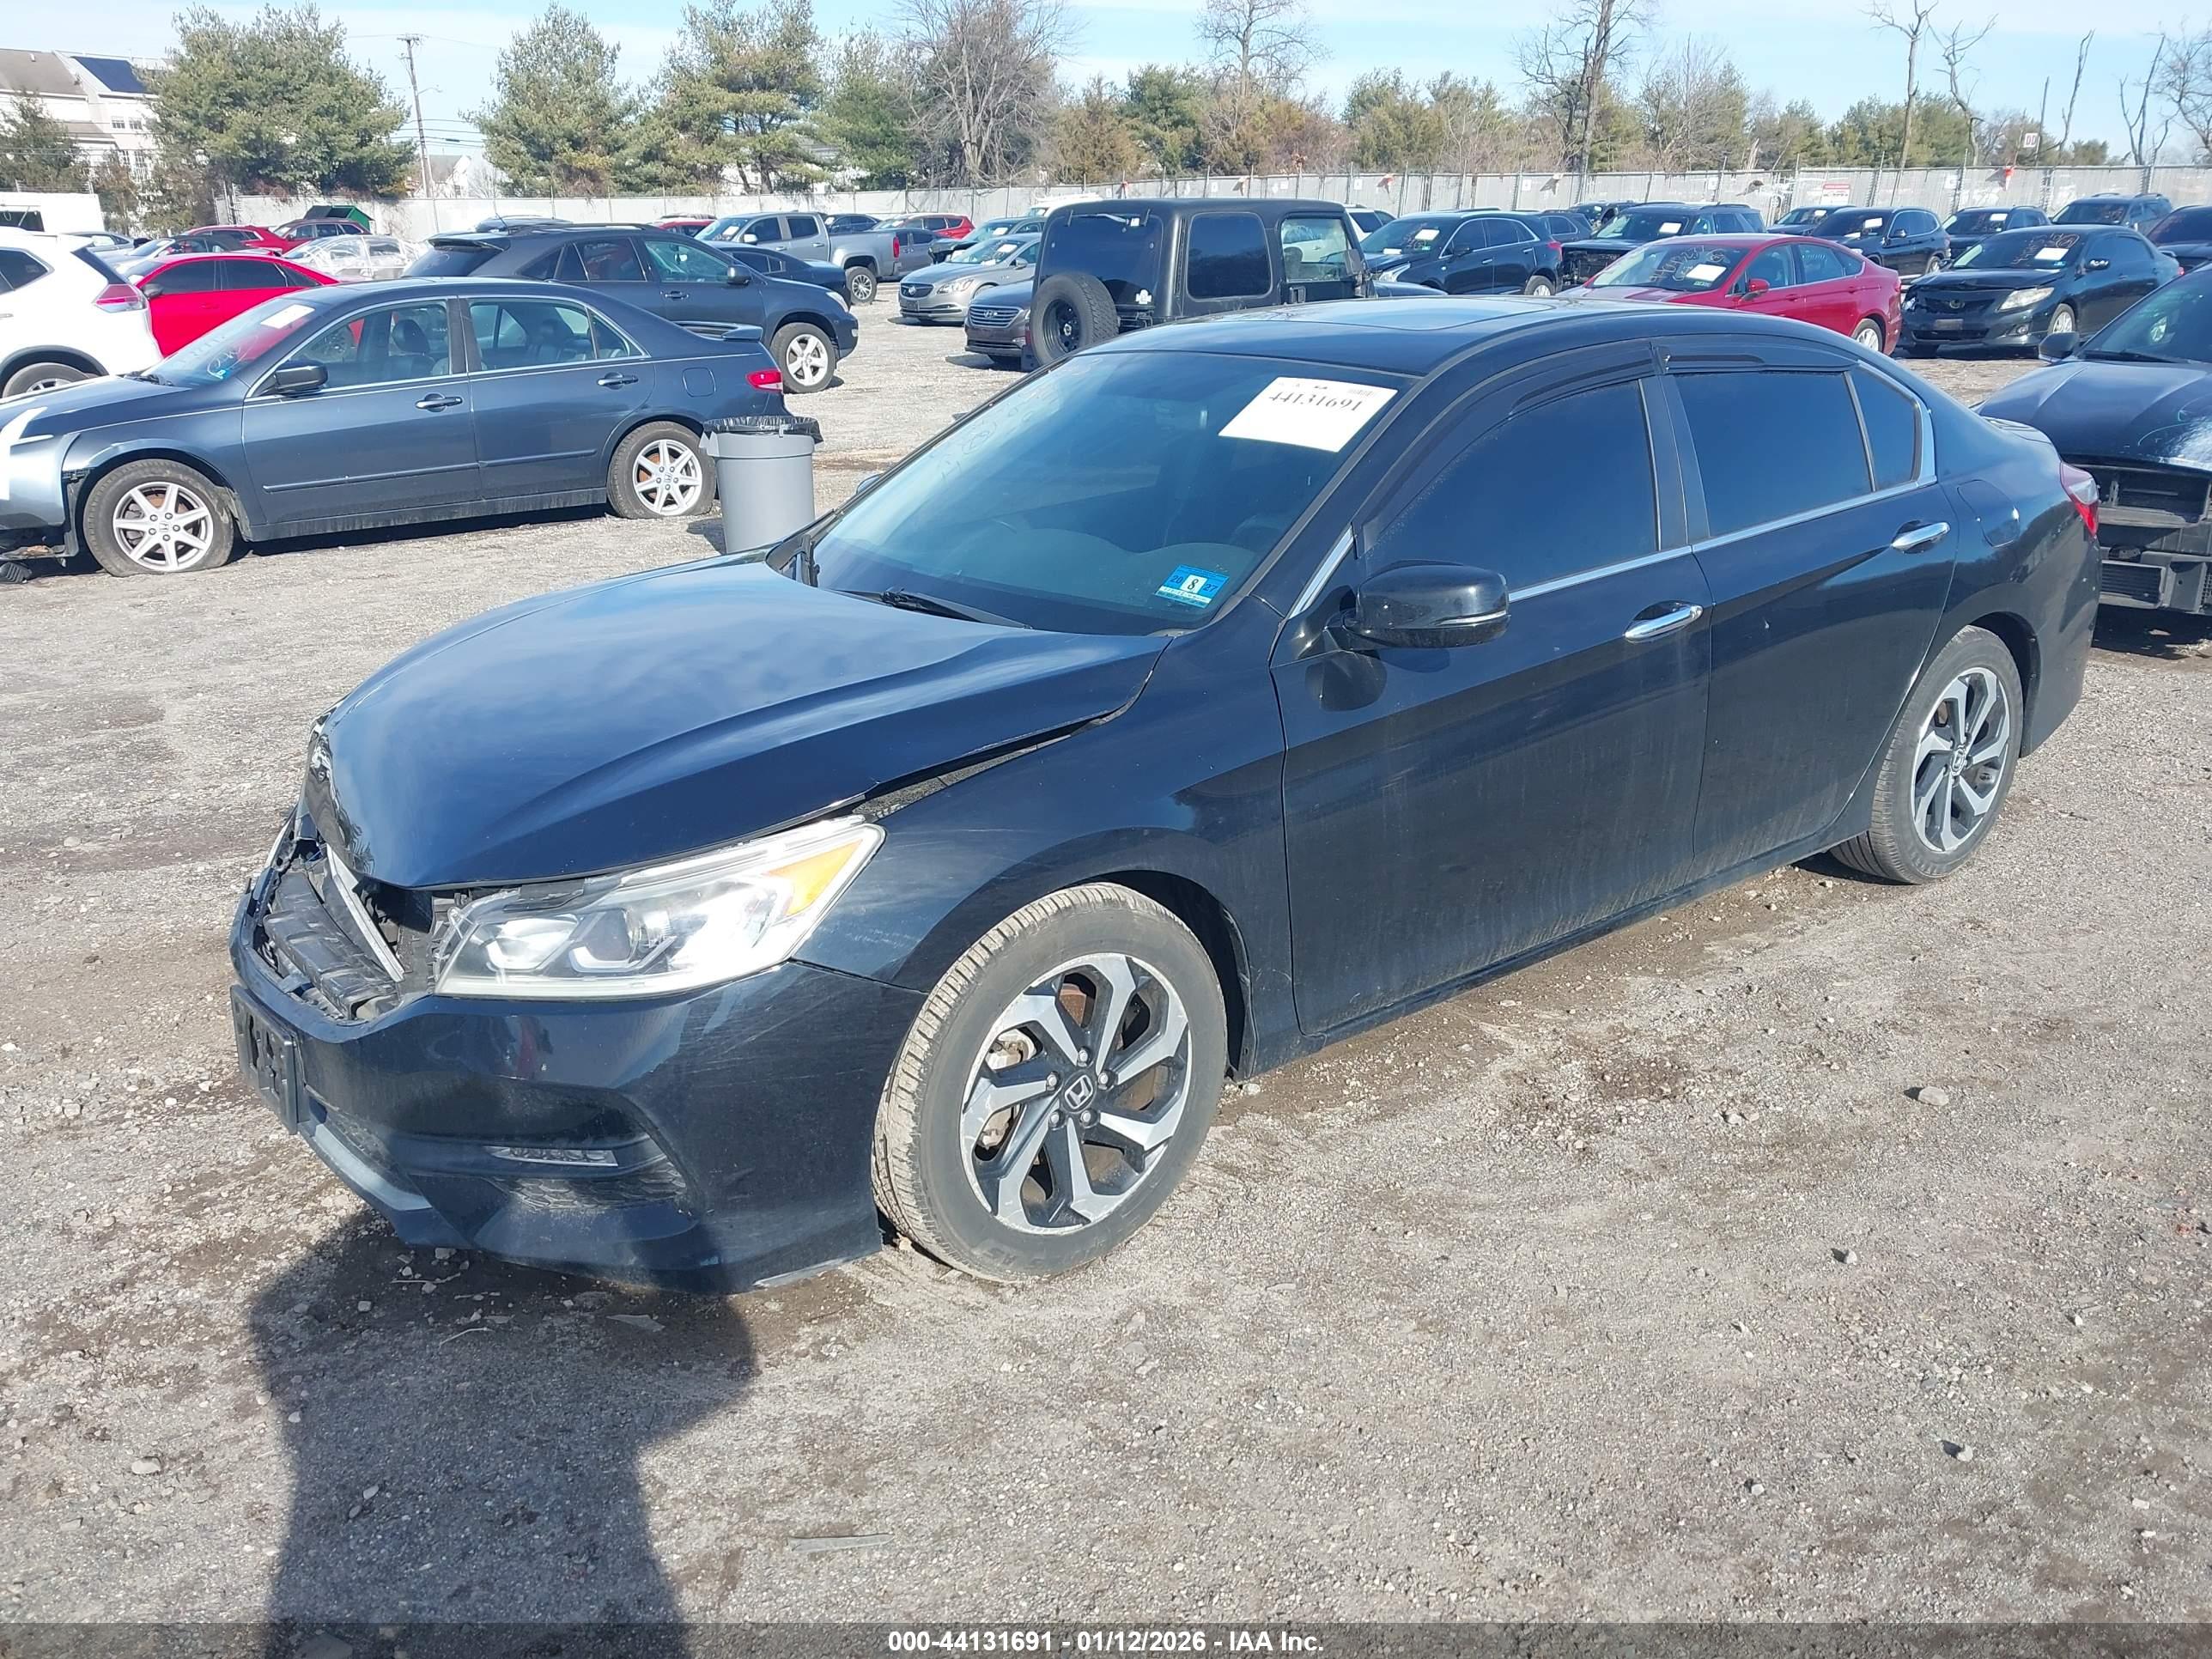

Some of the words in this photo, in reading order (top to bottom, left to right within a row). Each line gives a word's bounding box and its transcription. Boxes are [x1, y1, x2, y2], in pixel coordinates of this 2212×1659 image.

[1268, 391, 1363, 411] 44131691
[1170, 574, 1184, 584] 20
[1187, 578, 1200, 591] 8
